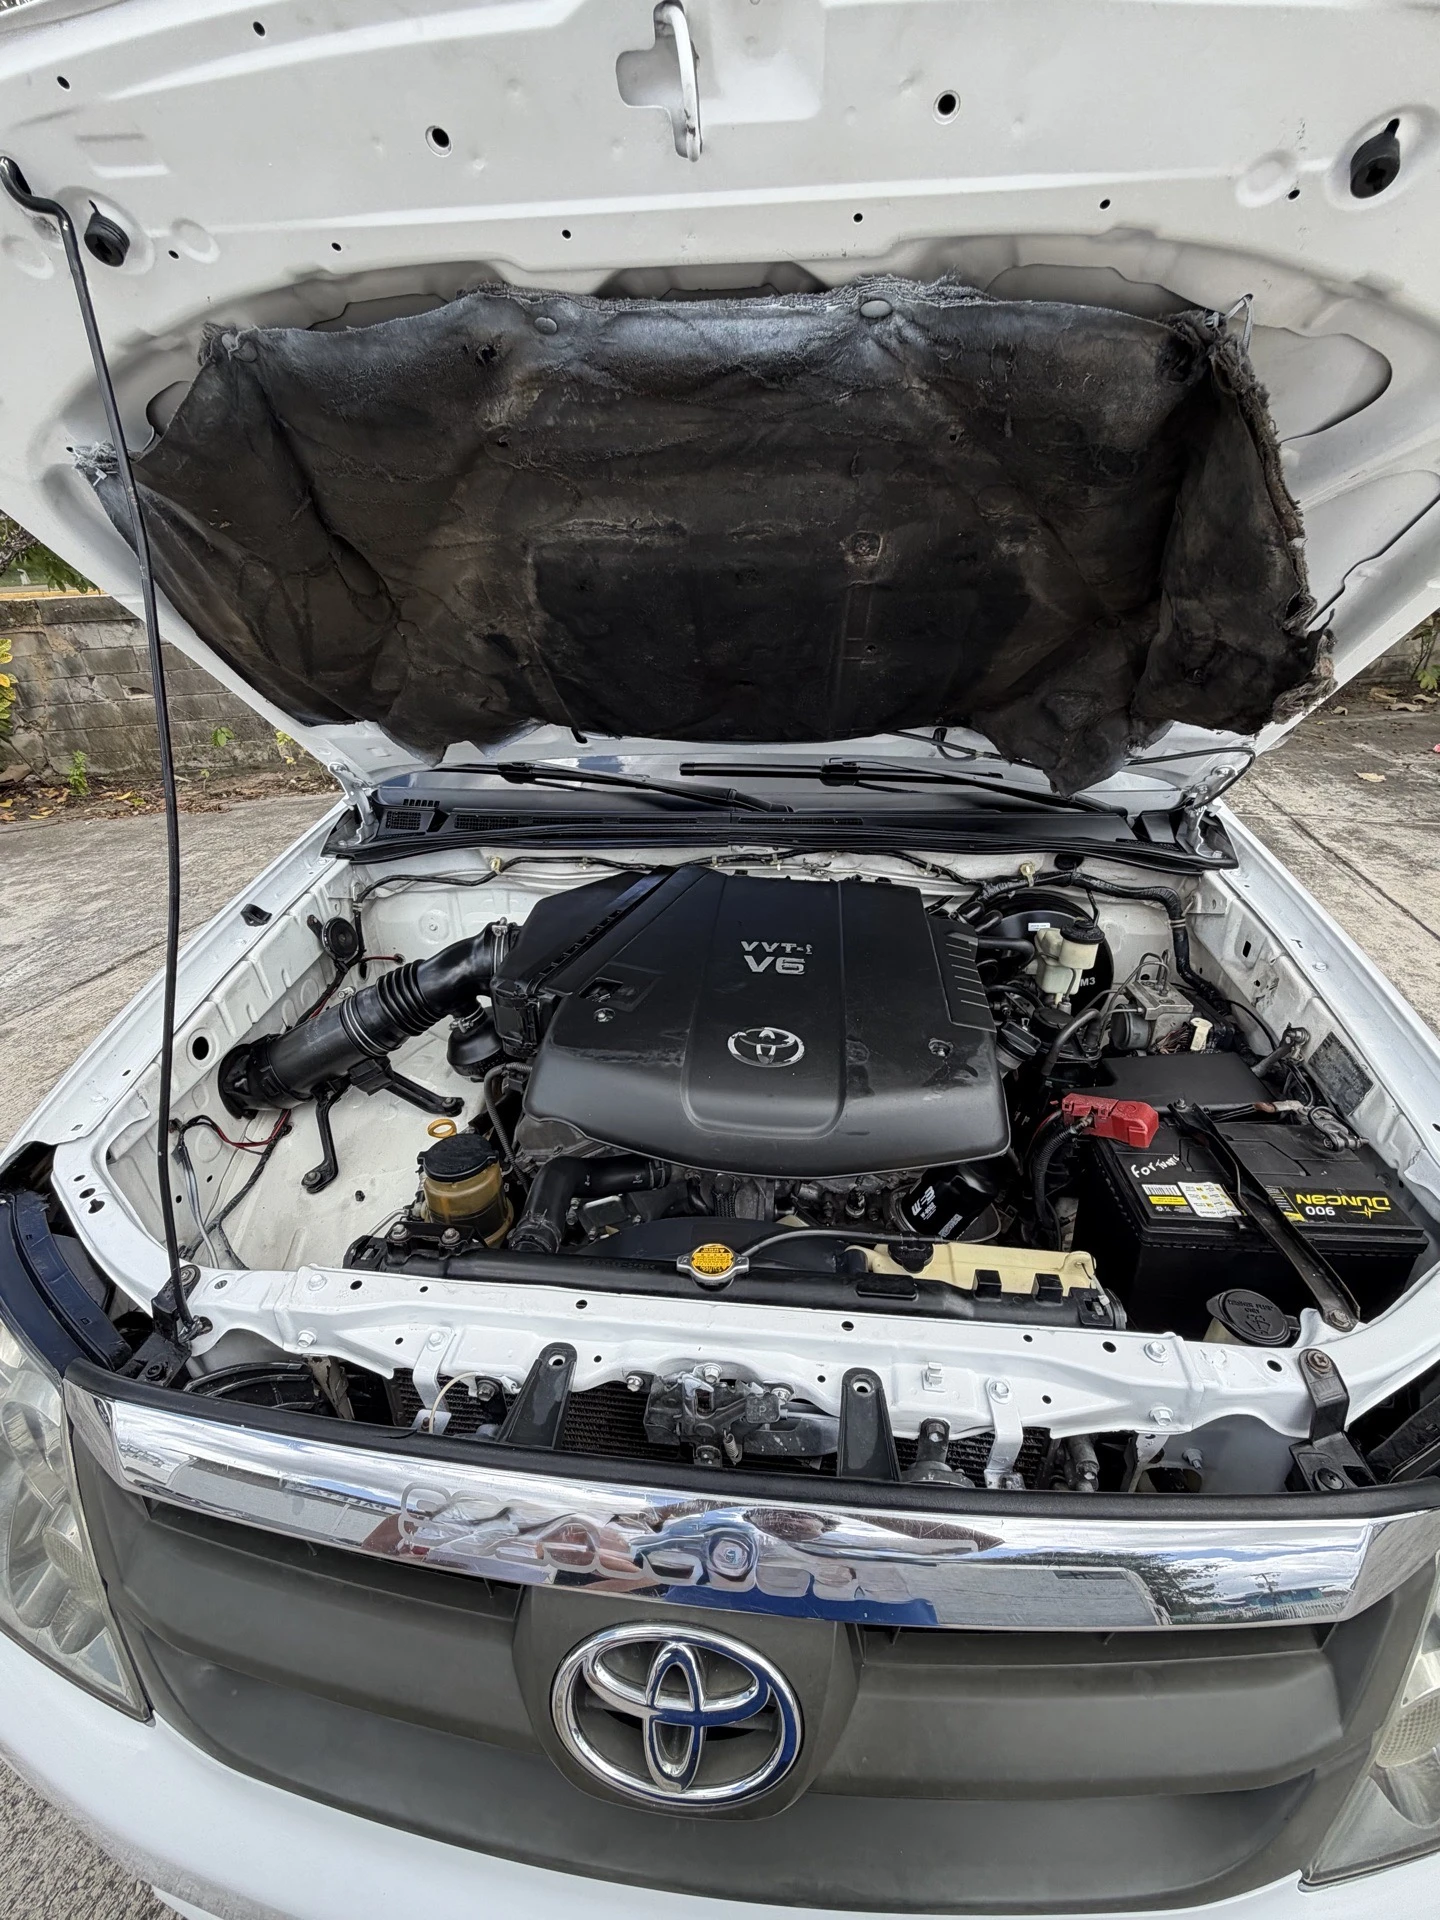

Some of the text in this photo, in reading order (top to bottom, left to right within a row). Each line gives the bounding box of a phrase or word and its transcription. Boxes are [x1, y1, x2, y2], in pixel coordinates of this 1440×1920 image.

[743, 955, 806, 975] V6
[1295, 1193, 1391, 1210] DUNCAN
[1305, 1206, 1336, 1216] 900
